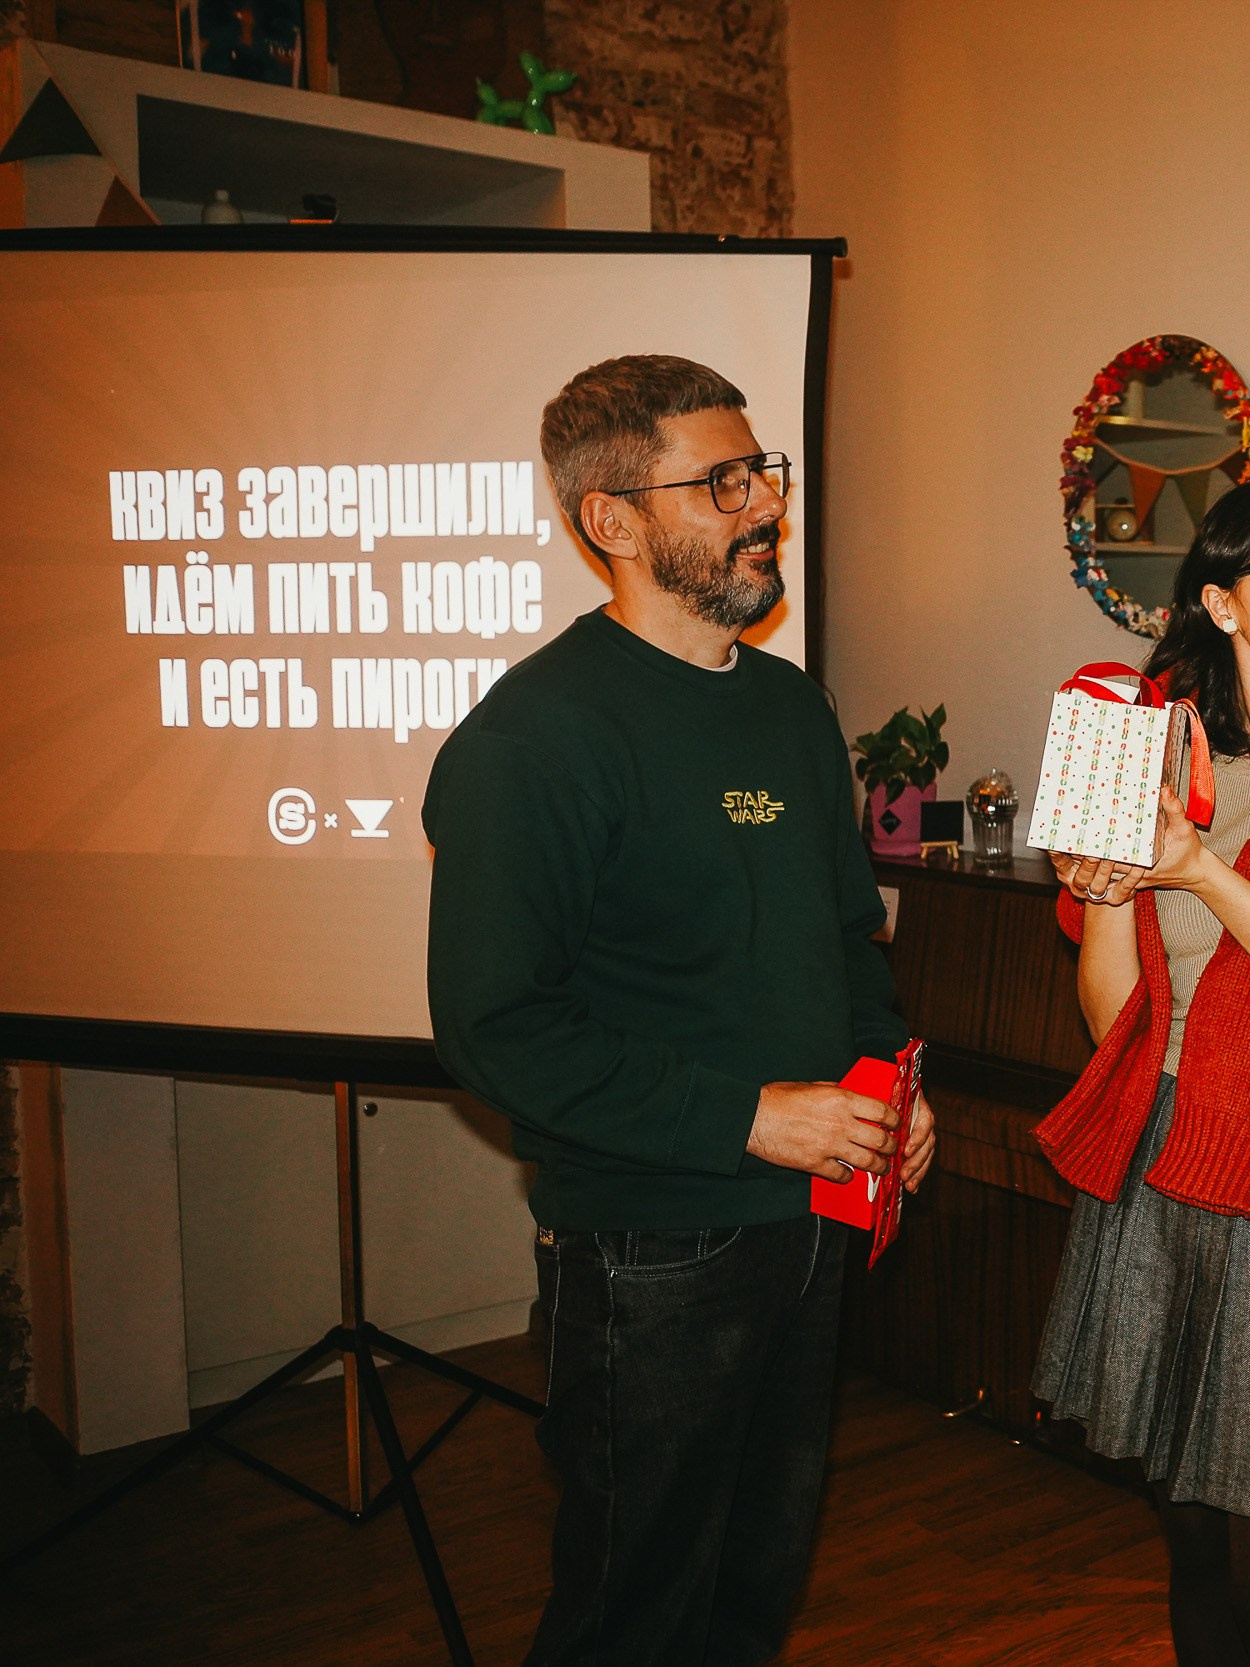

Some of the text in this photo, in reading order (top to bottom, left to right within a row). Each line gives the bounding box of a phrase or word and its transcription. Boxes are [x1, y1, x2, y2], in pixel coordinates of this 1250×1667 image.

[109, 461, 551, 552] квиз завершили,
[123, 551, 543, 640] идём пить кофе
[159, 658, 189, 728] и
[200, 658, 318, 728] есть
[721, 790, 784, 809] STAR
[726, 806, 785, 825] WARS
